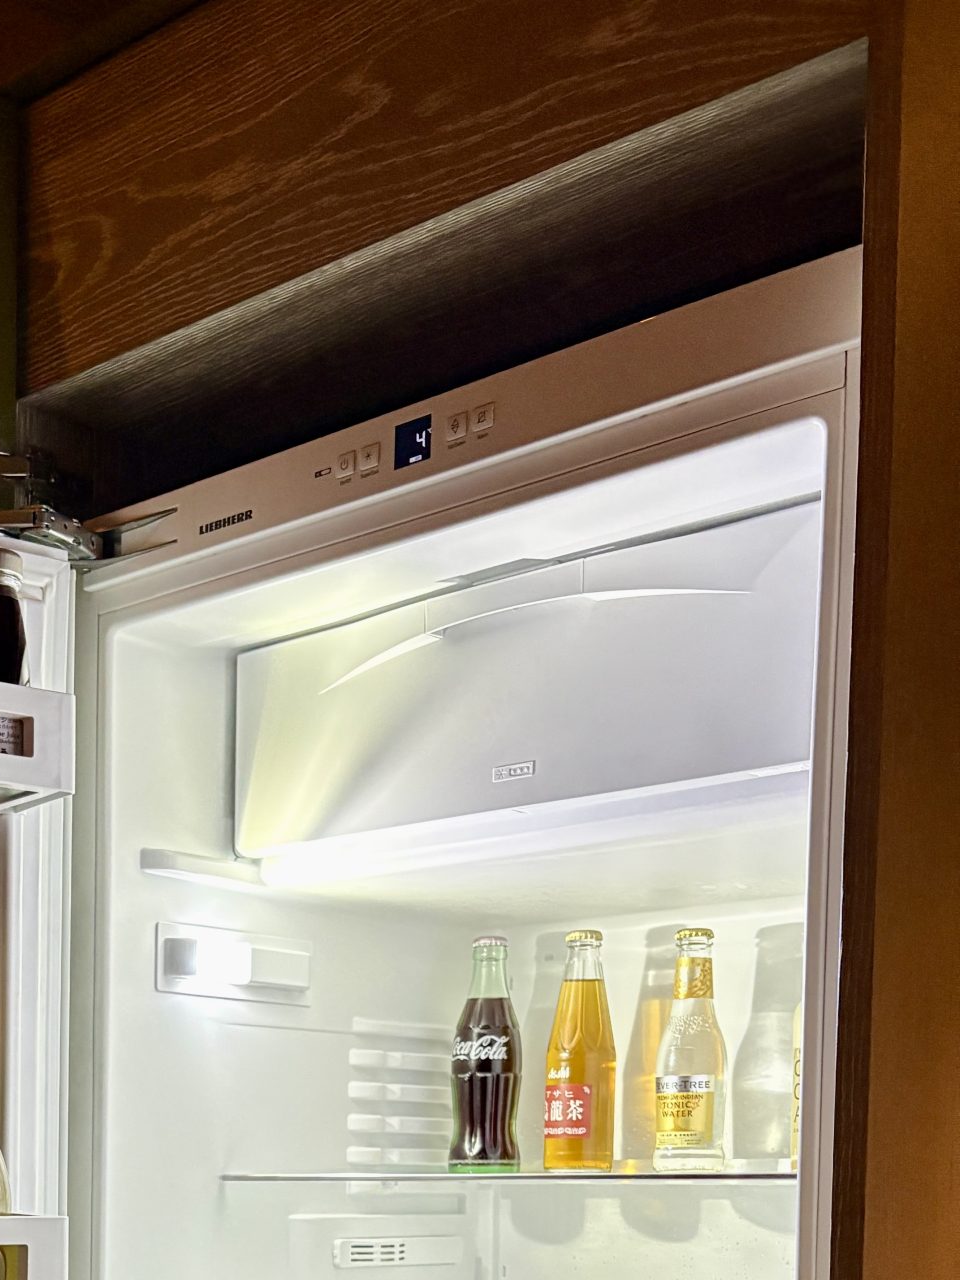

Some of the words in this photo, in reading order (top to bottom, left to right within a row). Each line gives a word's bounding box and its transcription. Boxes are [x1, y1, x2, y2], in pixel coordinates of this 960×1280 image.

[199, 510, 253, 535] LIEBHERR
[656, 1080, 711, 1090] EVER-TREE
[662, 1101, 692, 1109] TONIC
[662, 1110, 693, 1118] WATER
